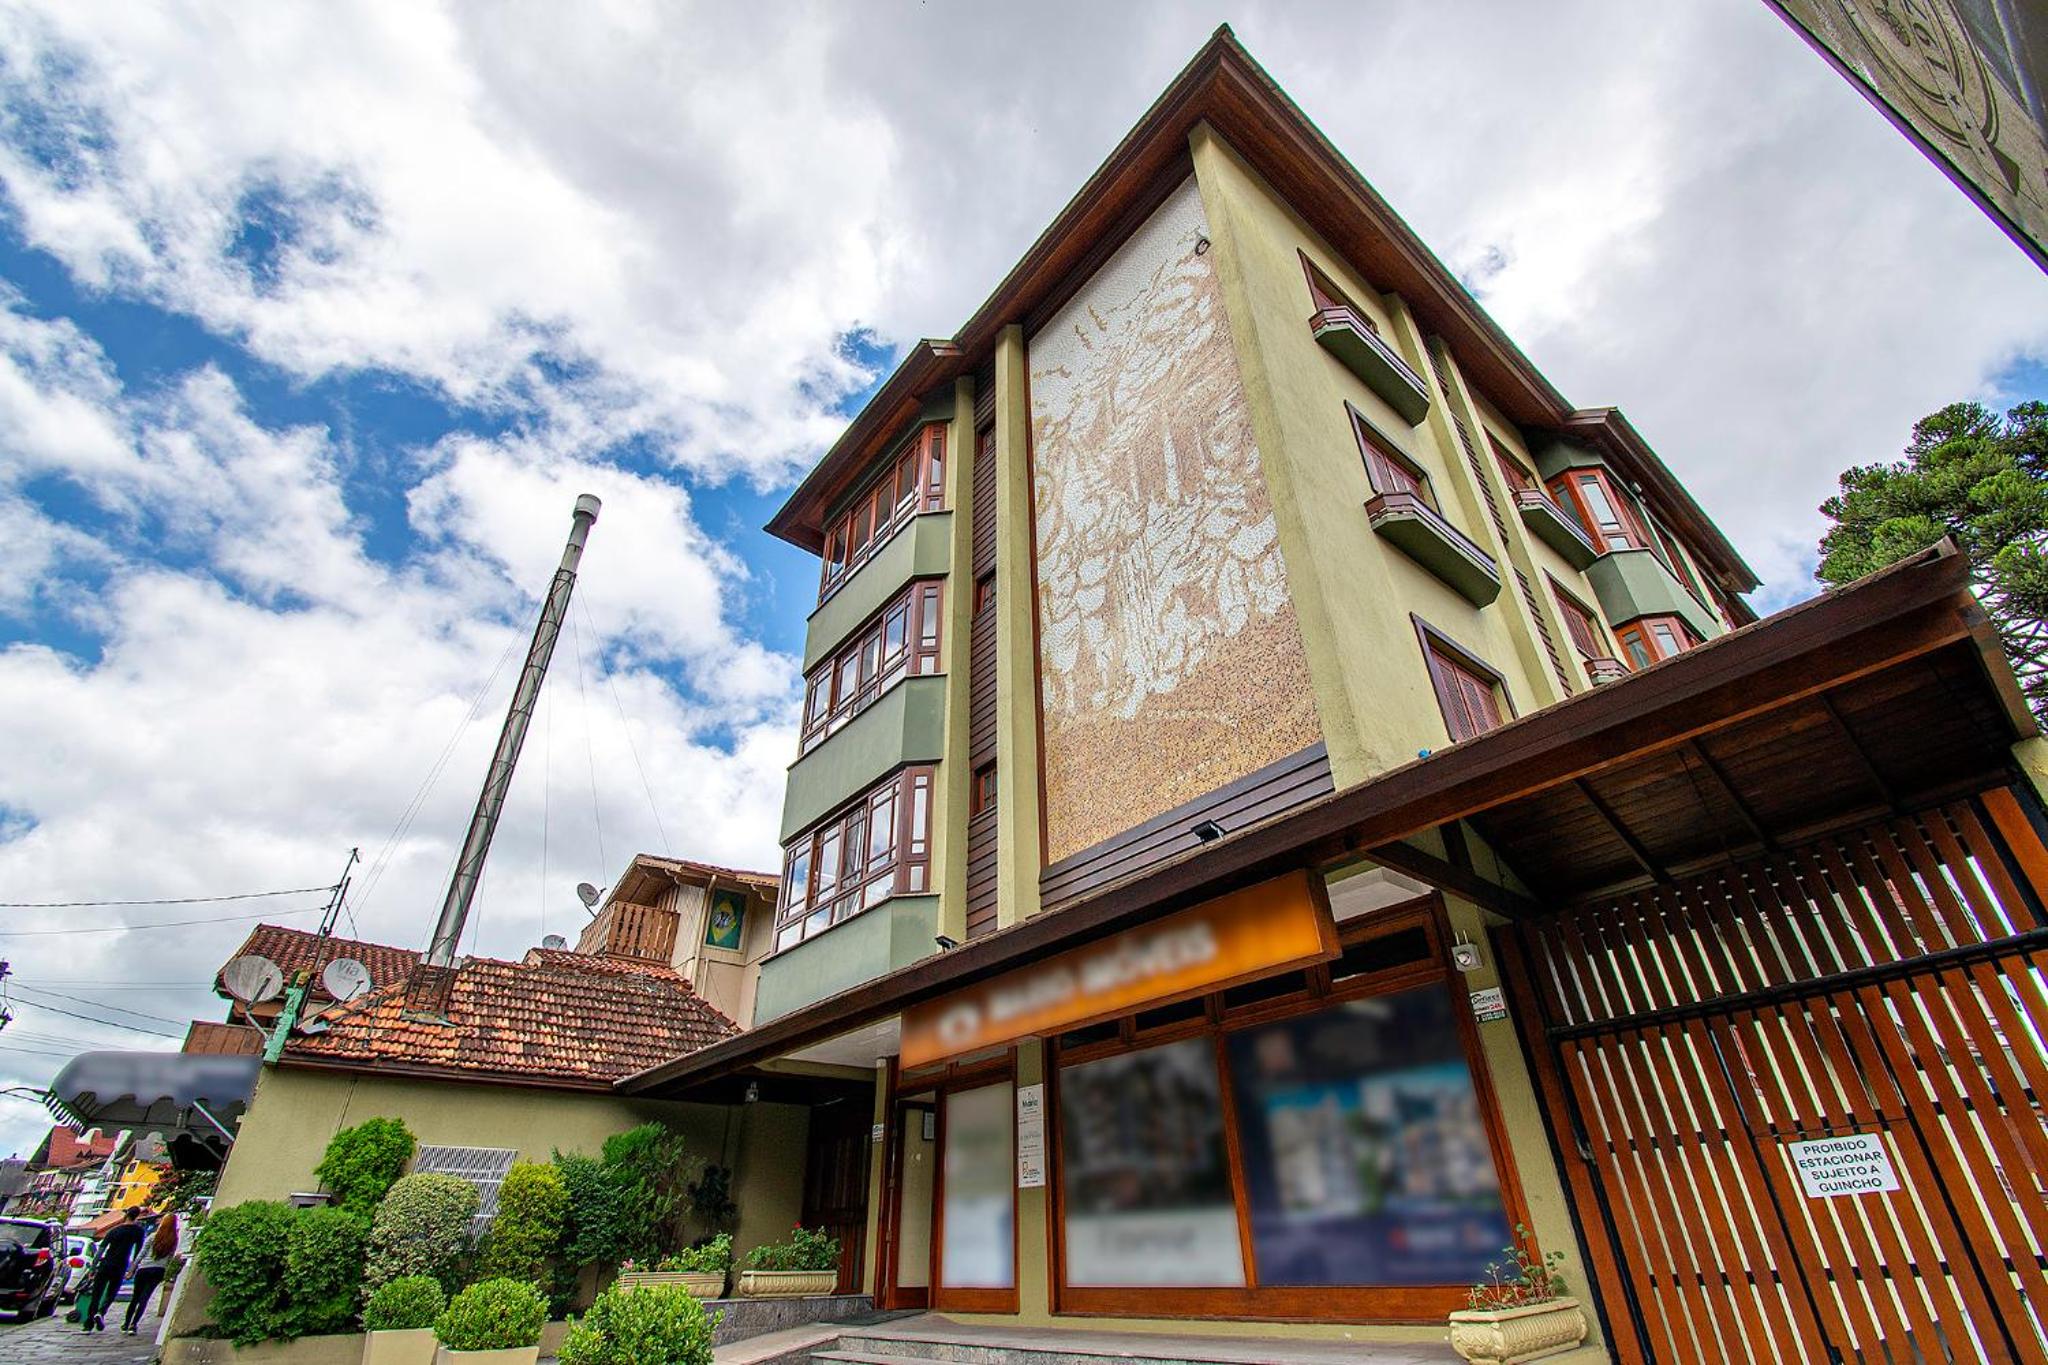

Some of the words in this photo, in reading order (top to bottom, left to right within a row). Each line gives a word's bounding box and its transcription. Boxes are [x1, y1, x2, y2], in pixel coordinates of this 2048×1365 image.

[1803, 1139, 1867, 1155] PROIBIDO
[1799, 1151, 1883, 1169] ESTACIONAR
[1811, 1165, 1867, 1180] SUJEITO
[1871, 1165, 1880, 1174] A
[1818, 1177, 1882, 1192] GUINCHO
